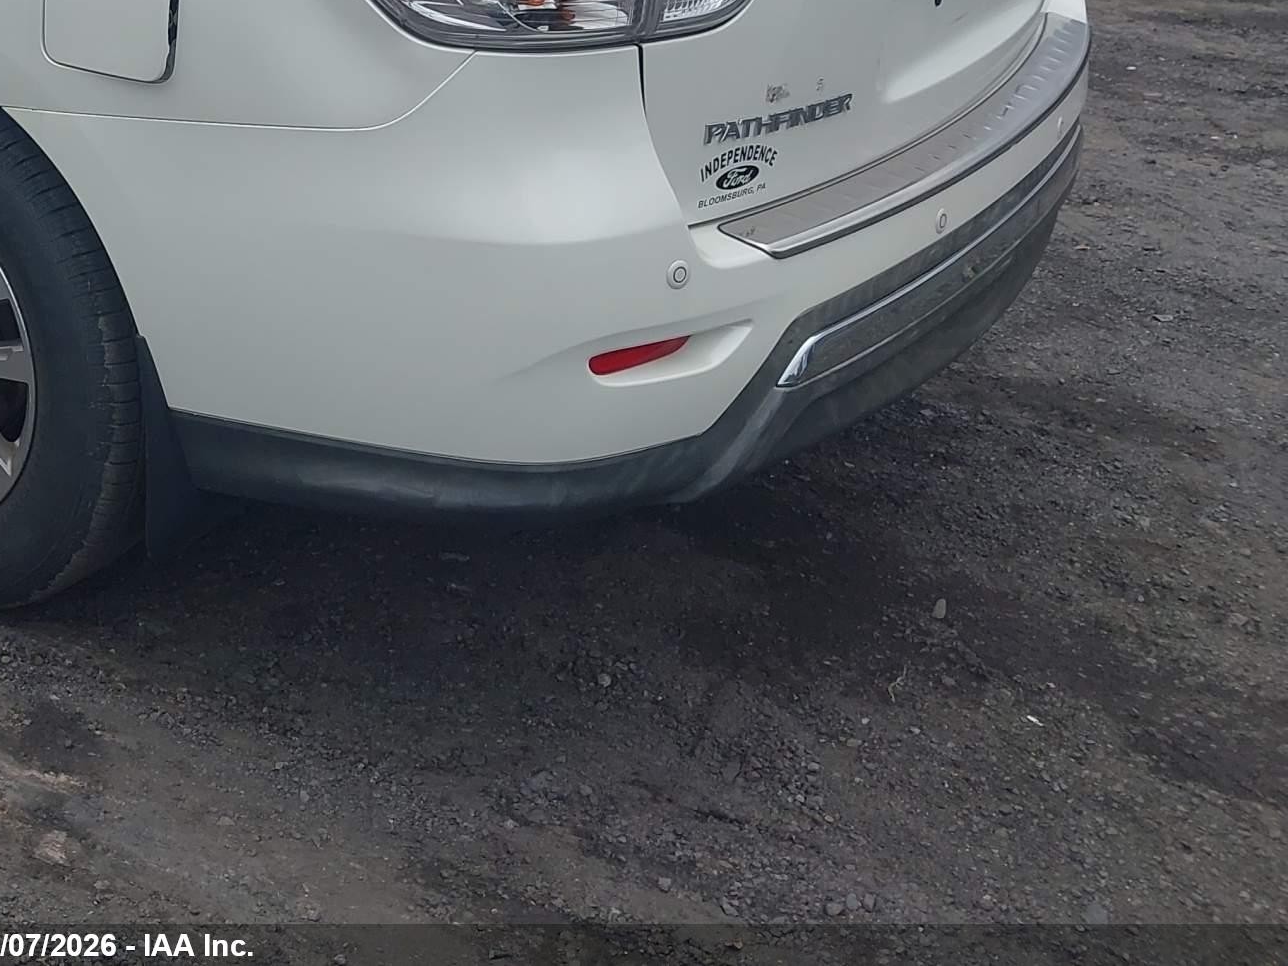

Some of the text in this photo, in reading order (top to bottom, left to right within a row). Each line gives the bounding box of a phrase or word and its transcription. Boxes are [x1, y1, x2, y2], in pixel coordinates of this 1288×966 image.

[703, 93, 853, 145] PATHFINDER
[700, 144, 778, 182] INDEPENDENCE
[721, 166, 756, 189] Ford
[698, 183, 767, 209] BLOOMSBURG, PA
